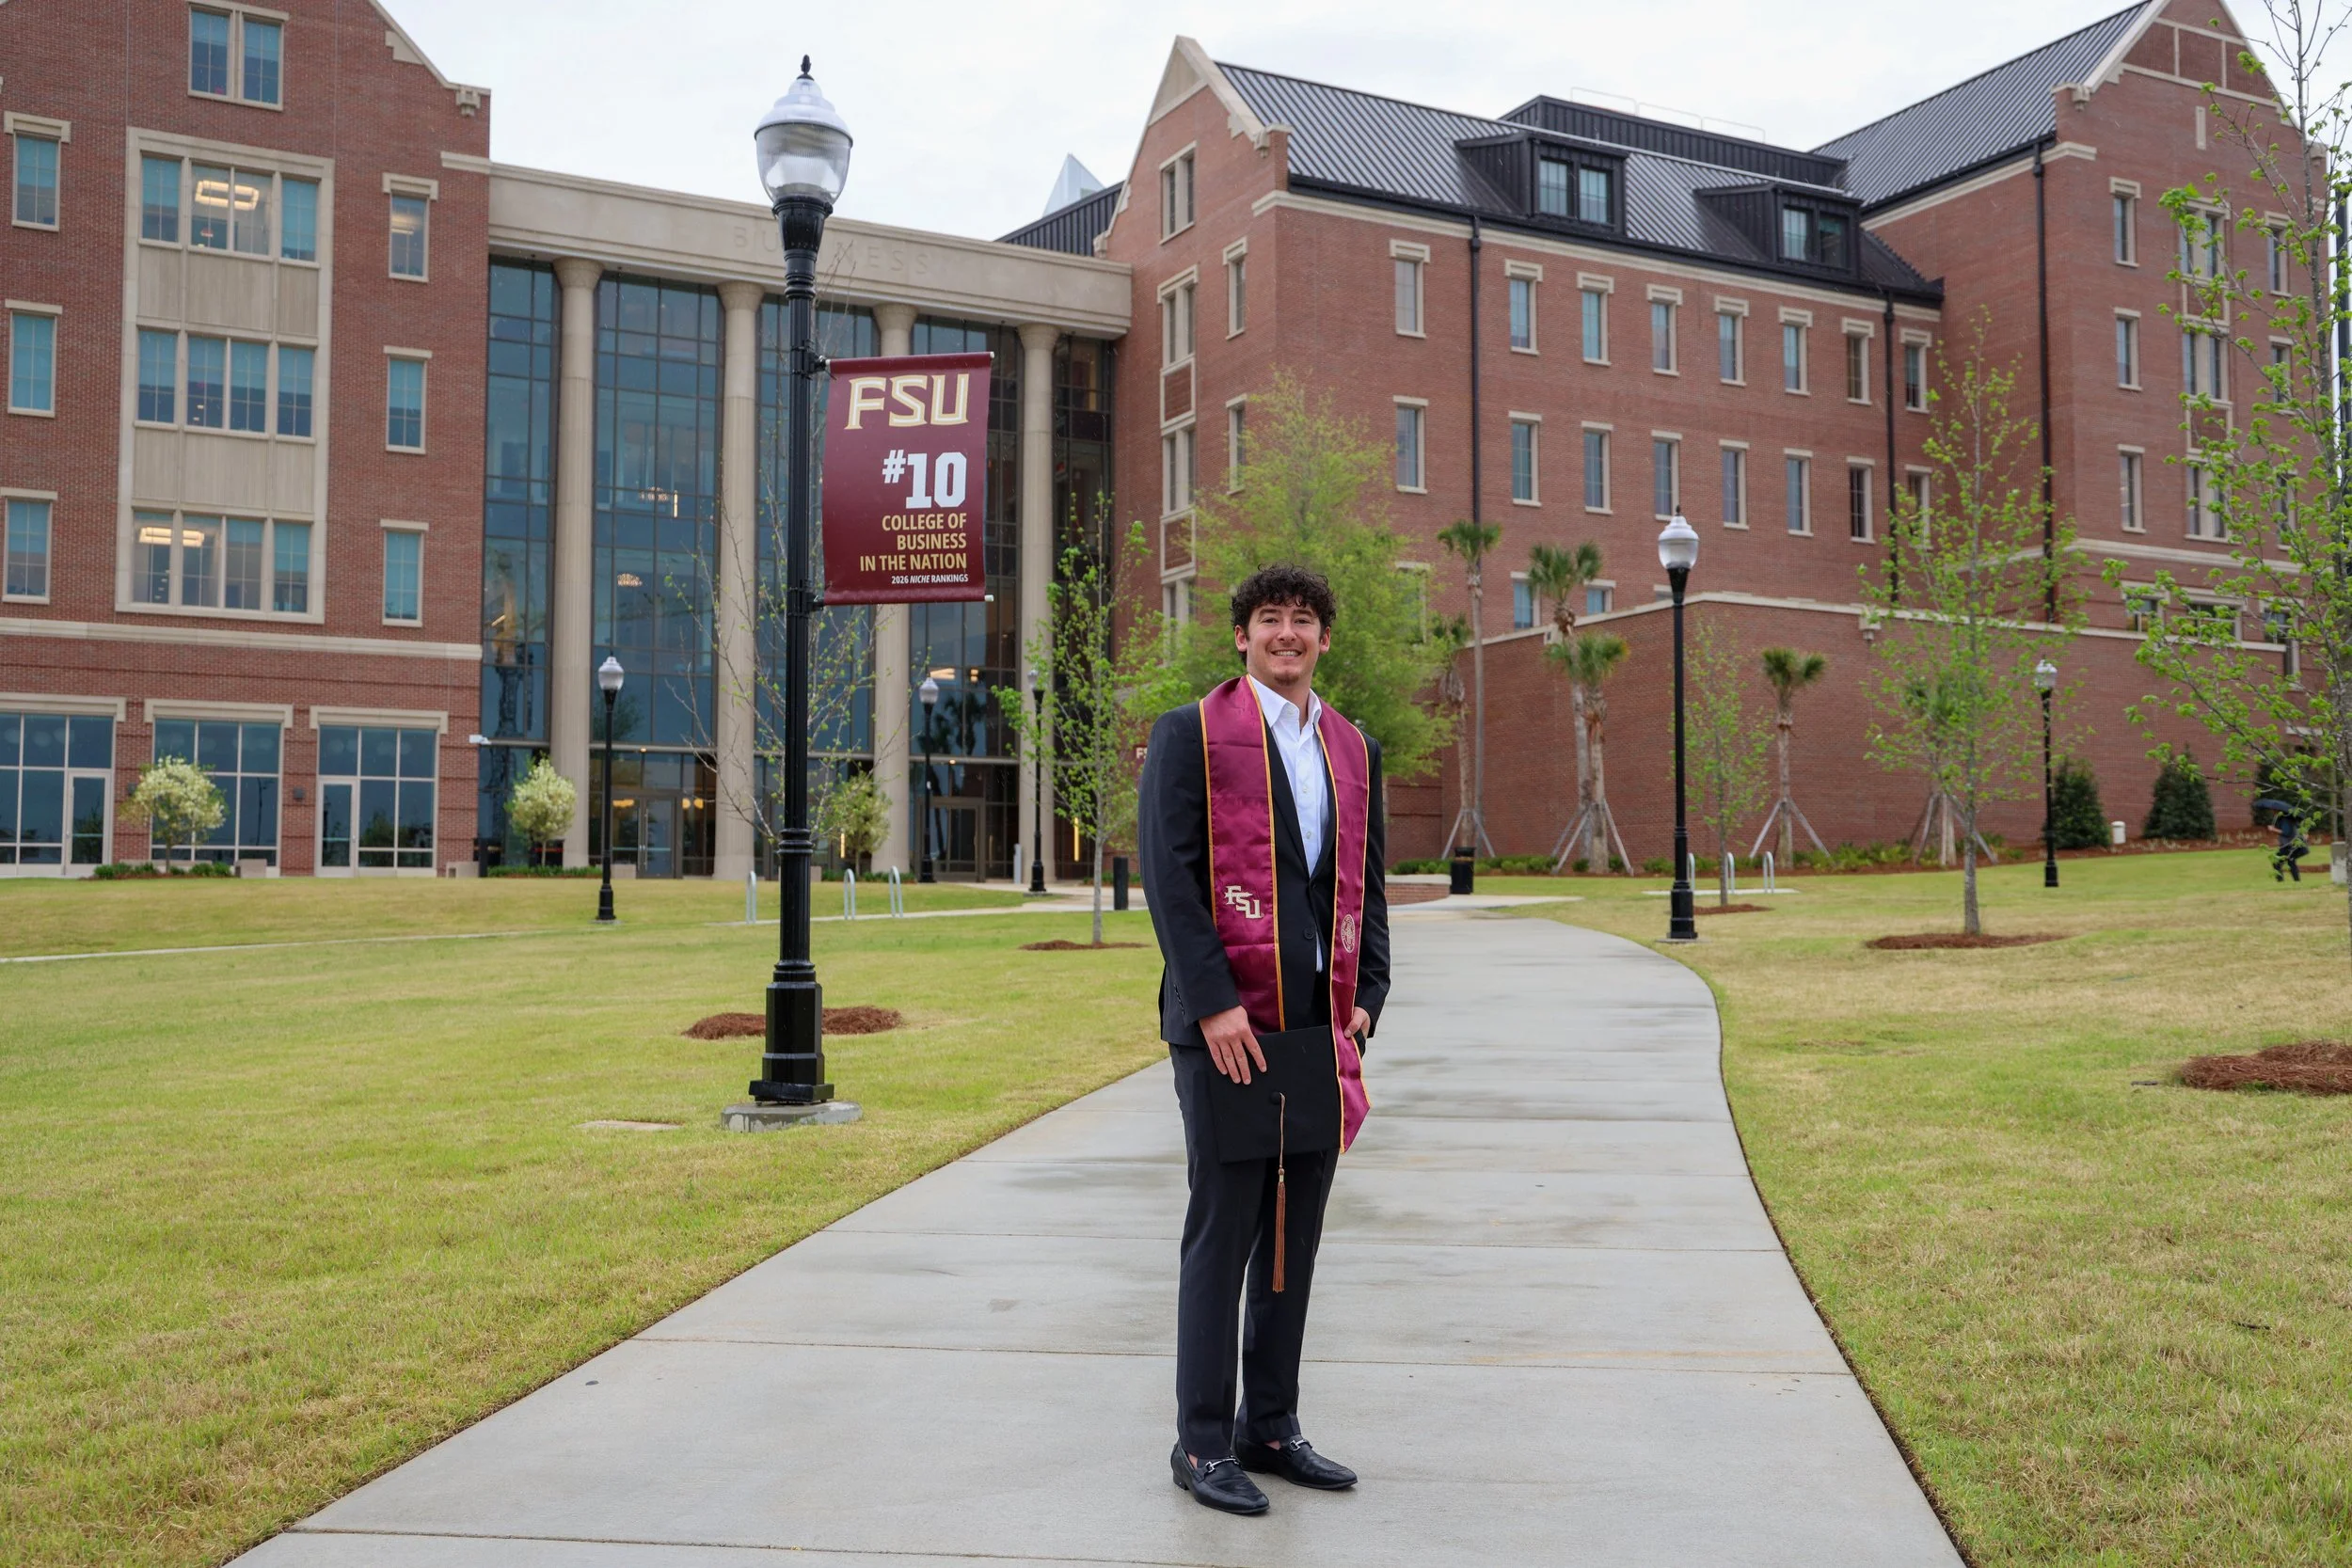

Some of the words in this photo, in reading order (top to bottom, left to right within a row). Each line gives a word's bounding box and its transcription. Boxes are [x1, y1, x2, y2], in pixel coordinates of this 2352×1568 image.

[732, 226, 930, 276] BUNESS
[844, 372, 969, 429] FSU
[882, 449, 967, 509] #10
[882, 514, 944, 531] COLLEGE
[947, 513, 967, 529] OF
[897, 532, 967, 550] BUSINESS
[860, 556, 876, 572] IN
[879, 554, 906, 571] THE
[910, 552, 967, 570] NATION
[891, 575, 909, 584] 2026
[910, 574, 930, 583] NICHE
[930, 573, 969, 582] RANKINGS
[1224, 885, 1262, 919] FSU
